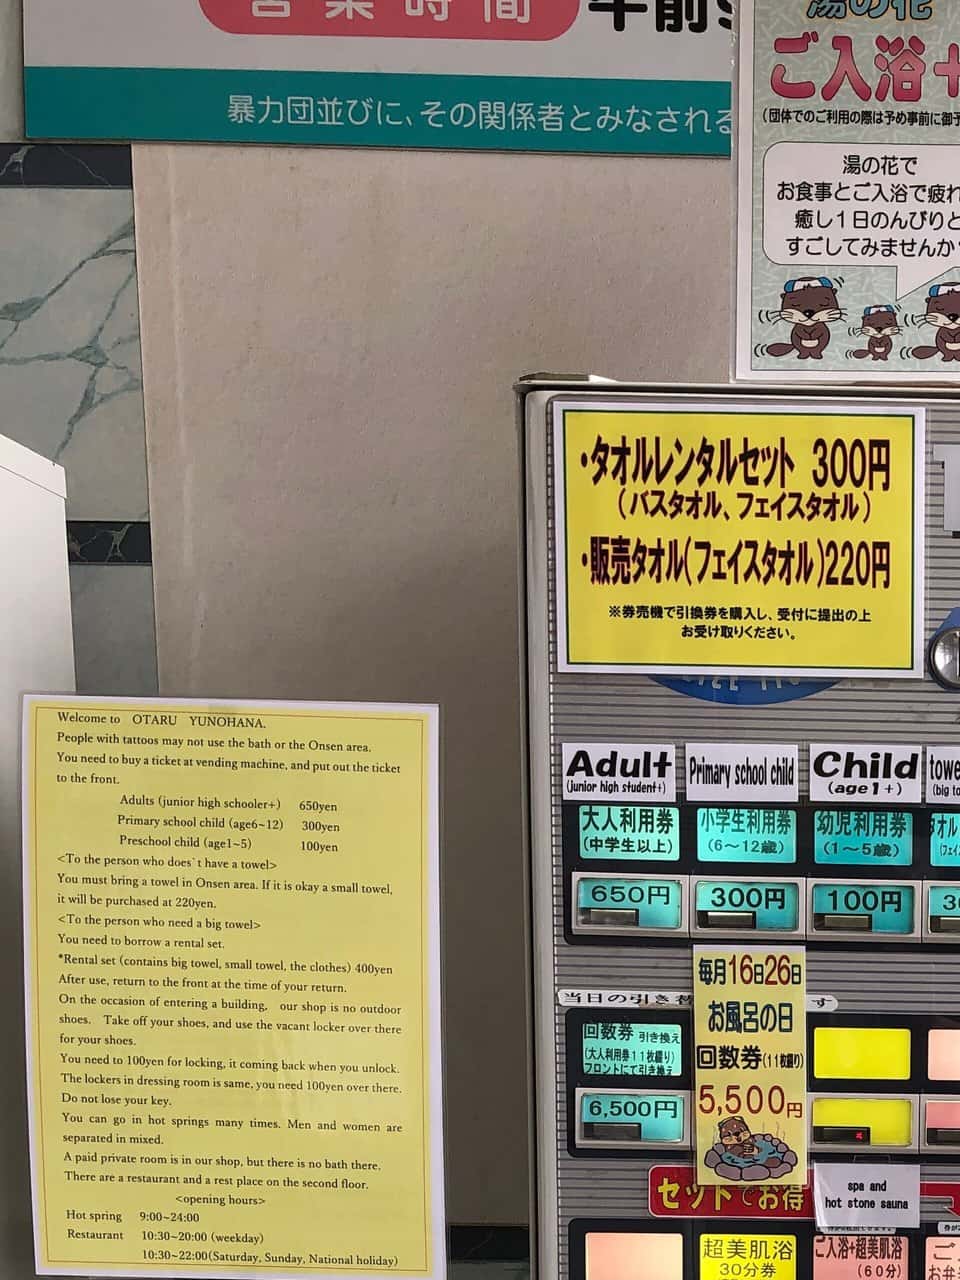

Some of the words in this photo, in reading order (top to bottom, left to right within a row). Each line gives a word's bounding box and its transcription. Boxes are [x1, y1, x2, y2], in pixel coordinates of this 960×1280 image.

[228, 94, 732, 134] 暴力団並びに、その関係者とみなされる
[843, 155, 916, 175] 湯の花で
[812, 438, 890, 491] 300円
[681, 625, 796, 640] お受け取りください。
[58, 712, 106, 723] Welcome
[133, 714, 176, 725] OTARU
[566, 750, 672, 778] Adult
[690, 756, 730, 789] Primary
[735, 757, 767, 786] school
[770, 757, 793, 786] child
[814, 751, 918, 779] Child
[567, 782, 597, 793] (junior
[600, 781, 619, 794] high
[933, 786, 949, 798] (big
[120, 795, 154, 805] Adults
[198, 797, 220, 809] high
[299, 801, 337, 813] 650yen
[118, 815, 160, 828] Primary
[163, 816, 196, 827] school
[200, 817, 224, 828] child
[302, 821, 339, 833] 300yen
[583, 808, 673, 834] 大人利用券
[701, 810, 791, 835] 小学生利用券
[817, 812, 906, 837] 幼児利用券
[583, 837, 672, 854] (中学生以上)
[591, 885, 670, 905] 650円
[712, 888, 785, 909] 300円
[828, 890, 902, 912] 100円
[698, 955, 801, 985] 毎月16日26日
[709, 1001, 792, 1033] お風呂の日
[584, 1024, 634, 1039] 回数券
[640, 1032, 681, 1044] 引き換え
[589, 1101, 677, 1119] 6,500円
[699, 1085, 803, 1119] 5,500円
[848, 1182, 864, 1193] spa
[870, 1180, 886, 1192] and
[825, 1198, 843, 1209] hot
[848, 1199, 875, 1209] stone
[881, 1199, 908, 1210] sauna
[703, 1239, 793, 1260] 超美肌浴
[720, 1263, 776, 1276] 30分券
